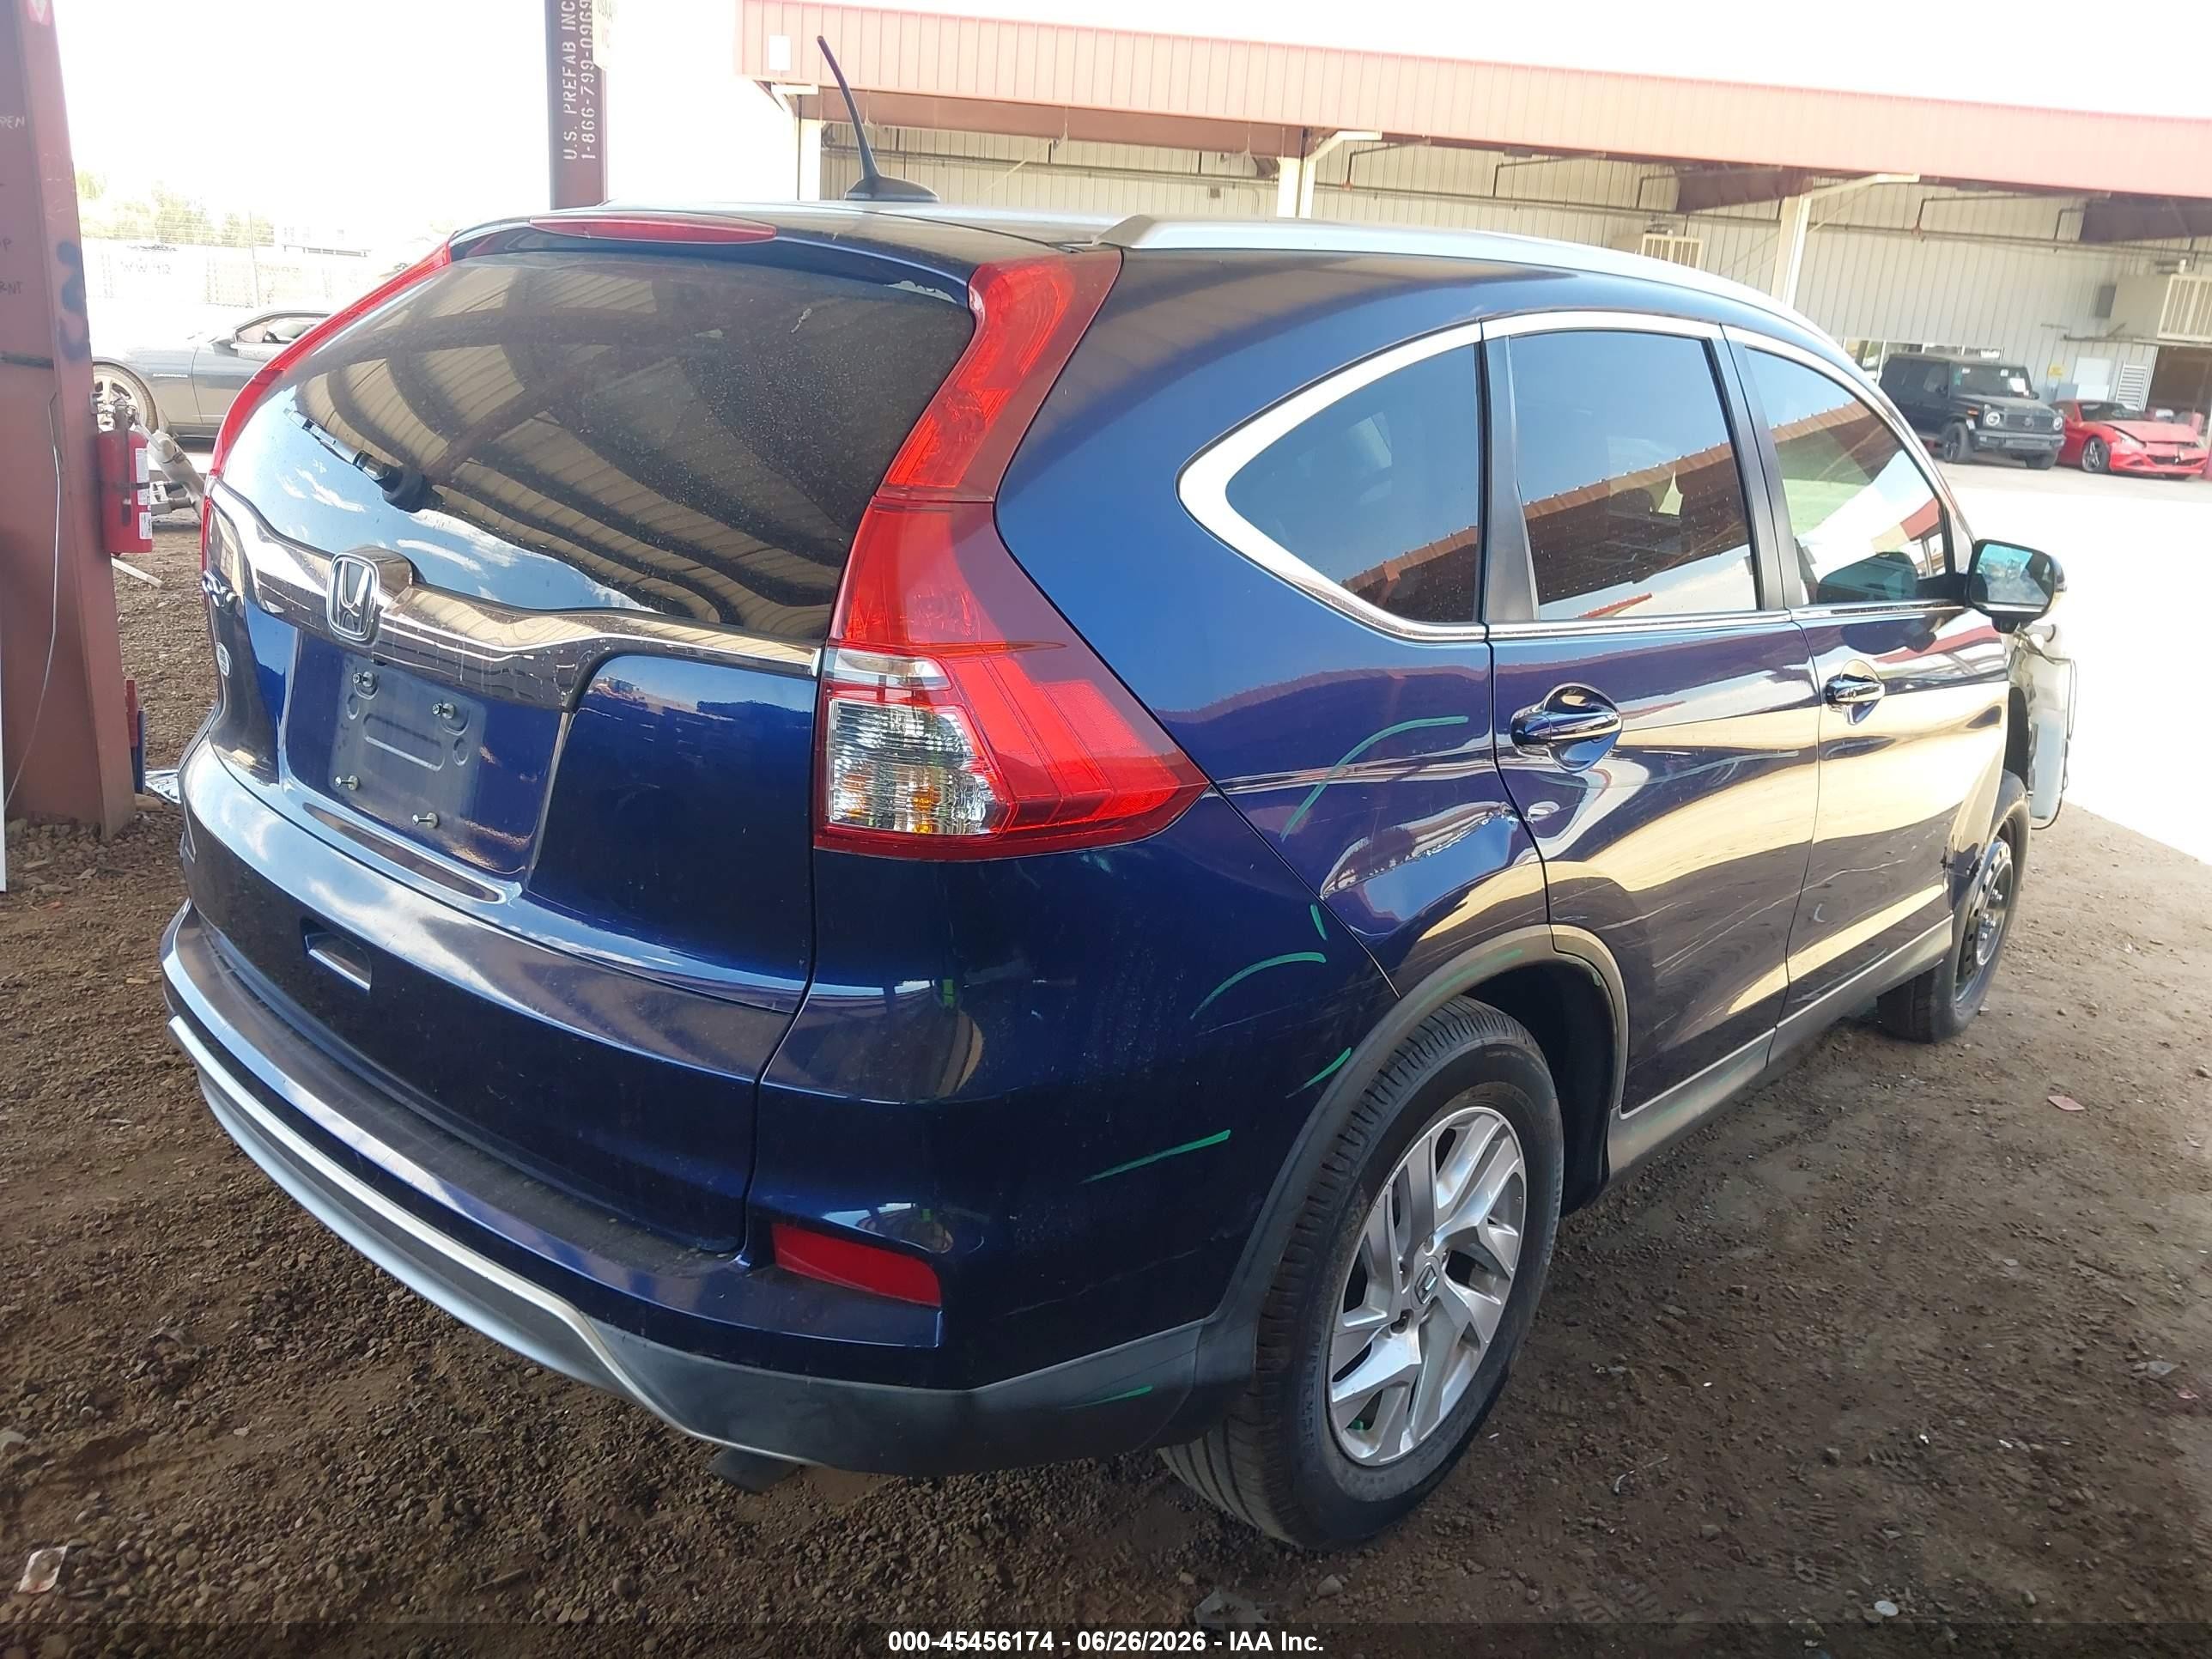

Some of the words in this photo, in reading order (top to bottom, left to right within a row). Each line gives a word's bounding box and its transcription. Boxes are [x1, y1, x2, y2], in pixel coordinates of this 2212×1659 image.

[561, 1, 576, 31] INC
[562, 41, 577, 114] PREFAB
[579, 0, 596, 159] 1-866-799-0969
[563, 125, 578, 160] U.S.
